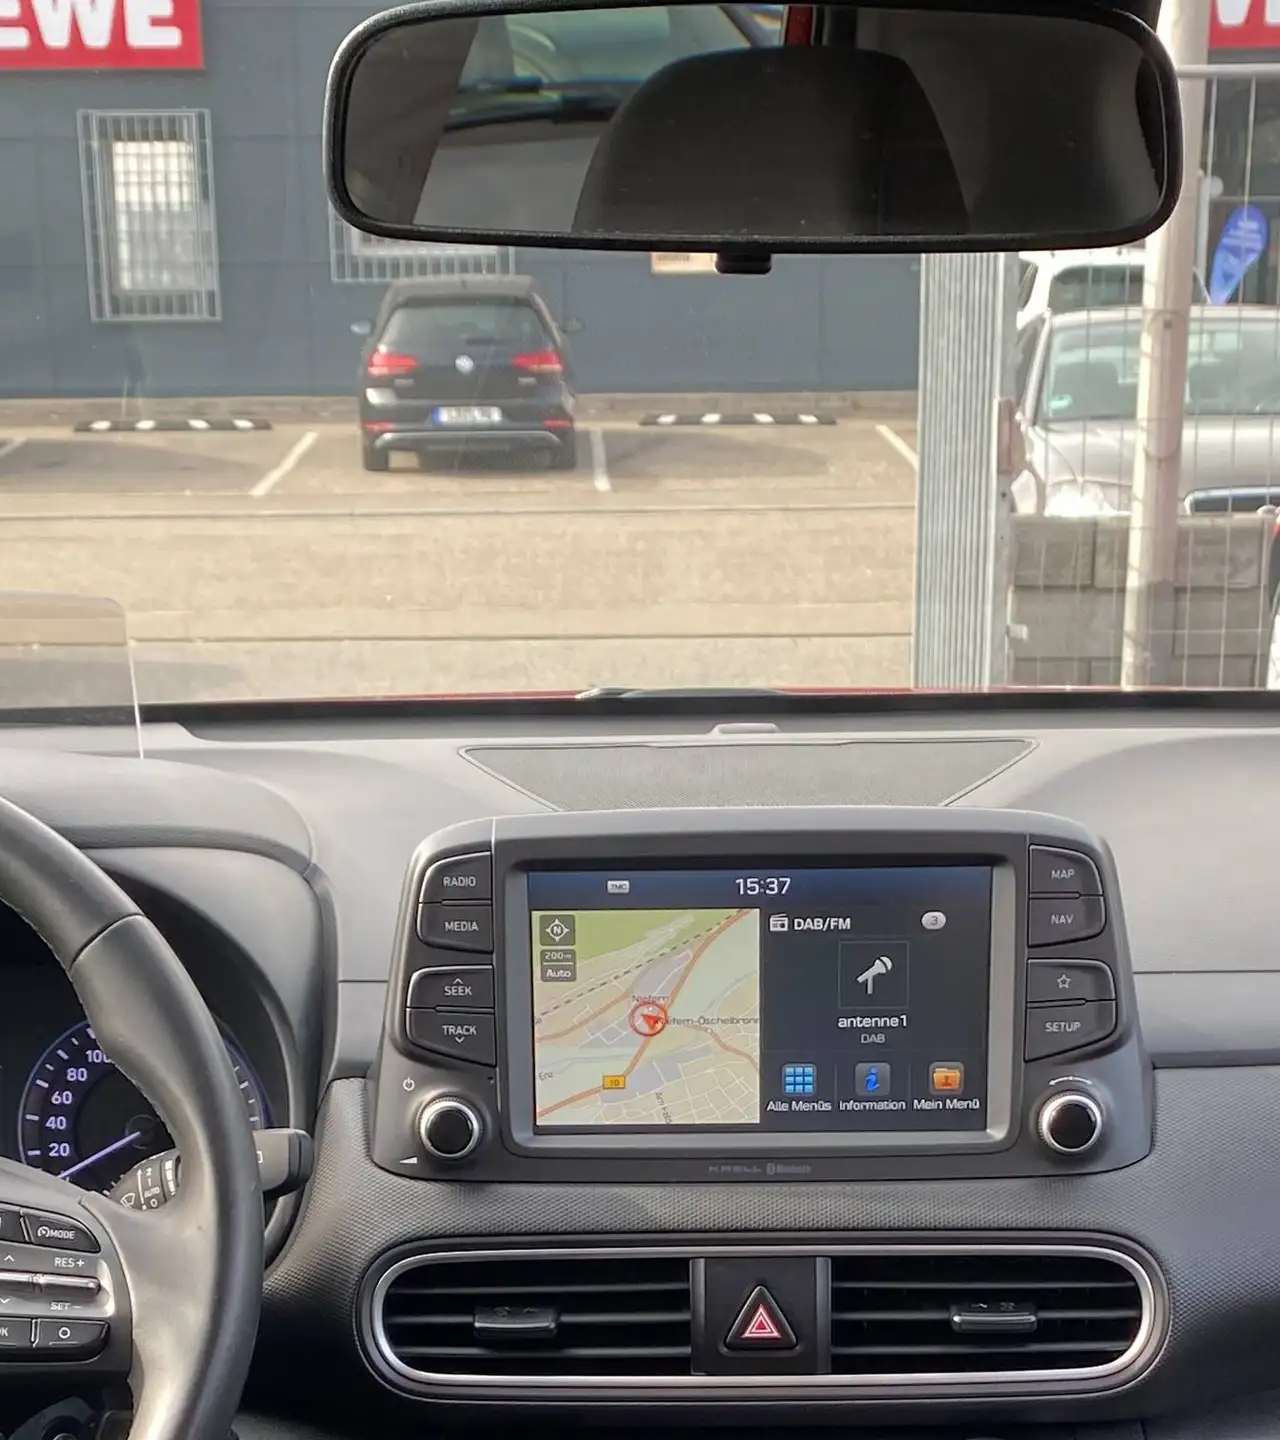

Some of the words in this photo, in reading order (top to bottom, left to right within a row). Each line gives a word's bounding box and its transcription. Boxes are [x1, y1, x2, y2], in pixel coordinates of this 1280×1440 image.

[1051, 869, 1075, 879] MAP
[443, 876, 476, 887] RADIO
[735, 877, 791, 895] 15:37
[794, 918, 851, 931] DAB/FM
[930, 916, 939, 926] 3
[1051, 914, 1074, 925] NAV
[444, 921, 479, 932] MEDIA
[546, 969, 571, 978] Auto
[444, 986, 472, 996] SEEK
[838, 1014, 907, 1028] antenne1
[442, 1025, 477, 1036] TRACK
[1045, 1022, 1081, 1033] SETUP
[861, 1033, 885, 1044] DAB
[66, 1067, 88, 1082] 80
[51, 1090, 73, 1105] 60
[766, 1101, 789, 1112] Alle
[791, 1100, 832, 1112] Menüs
[839, 1099, 906, 1111] Information
[913, 1098, 942, 1110] Mein
[945, 1098, 980, 1110] Menü
[45, 1116, 67, 1130] 40
[48, 1143, 70, 1157] 20
[50, 1229, 75, 1240] MODE
[50, 1302, 70, 1311] SET
